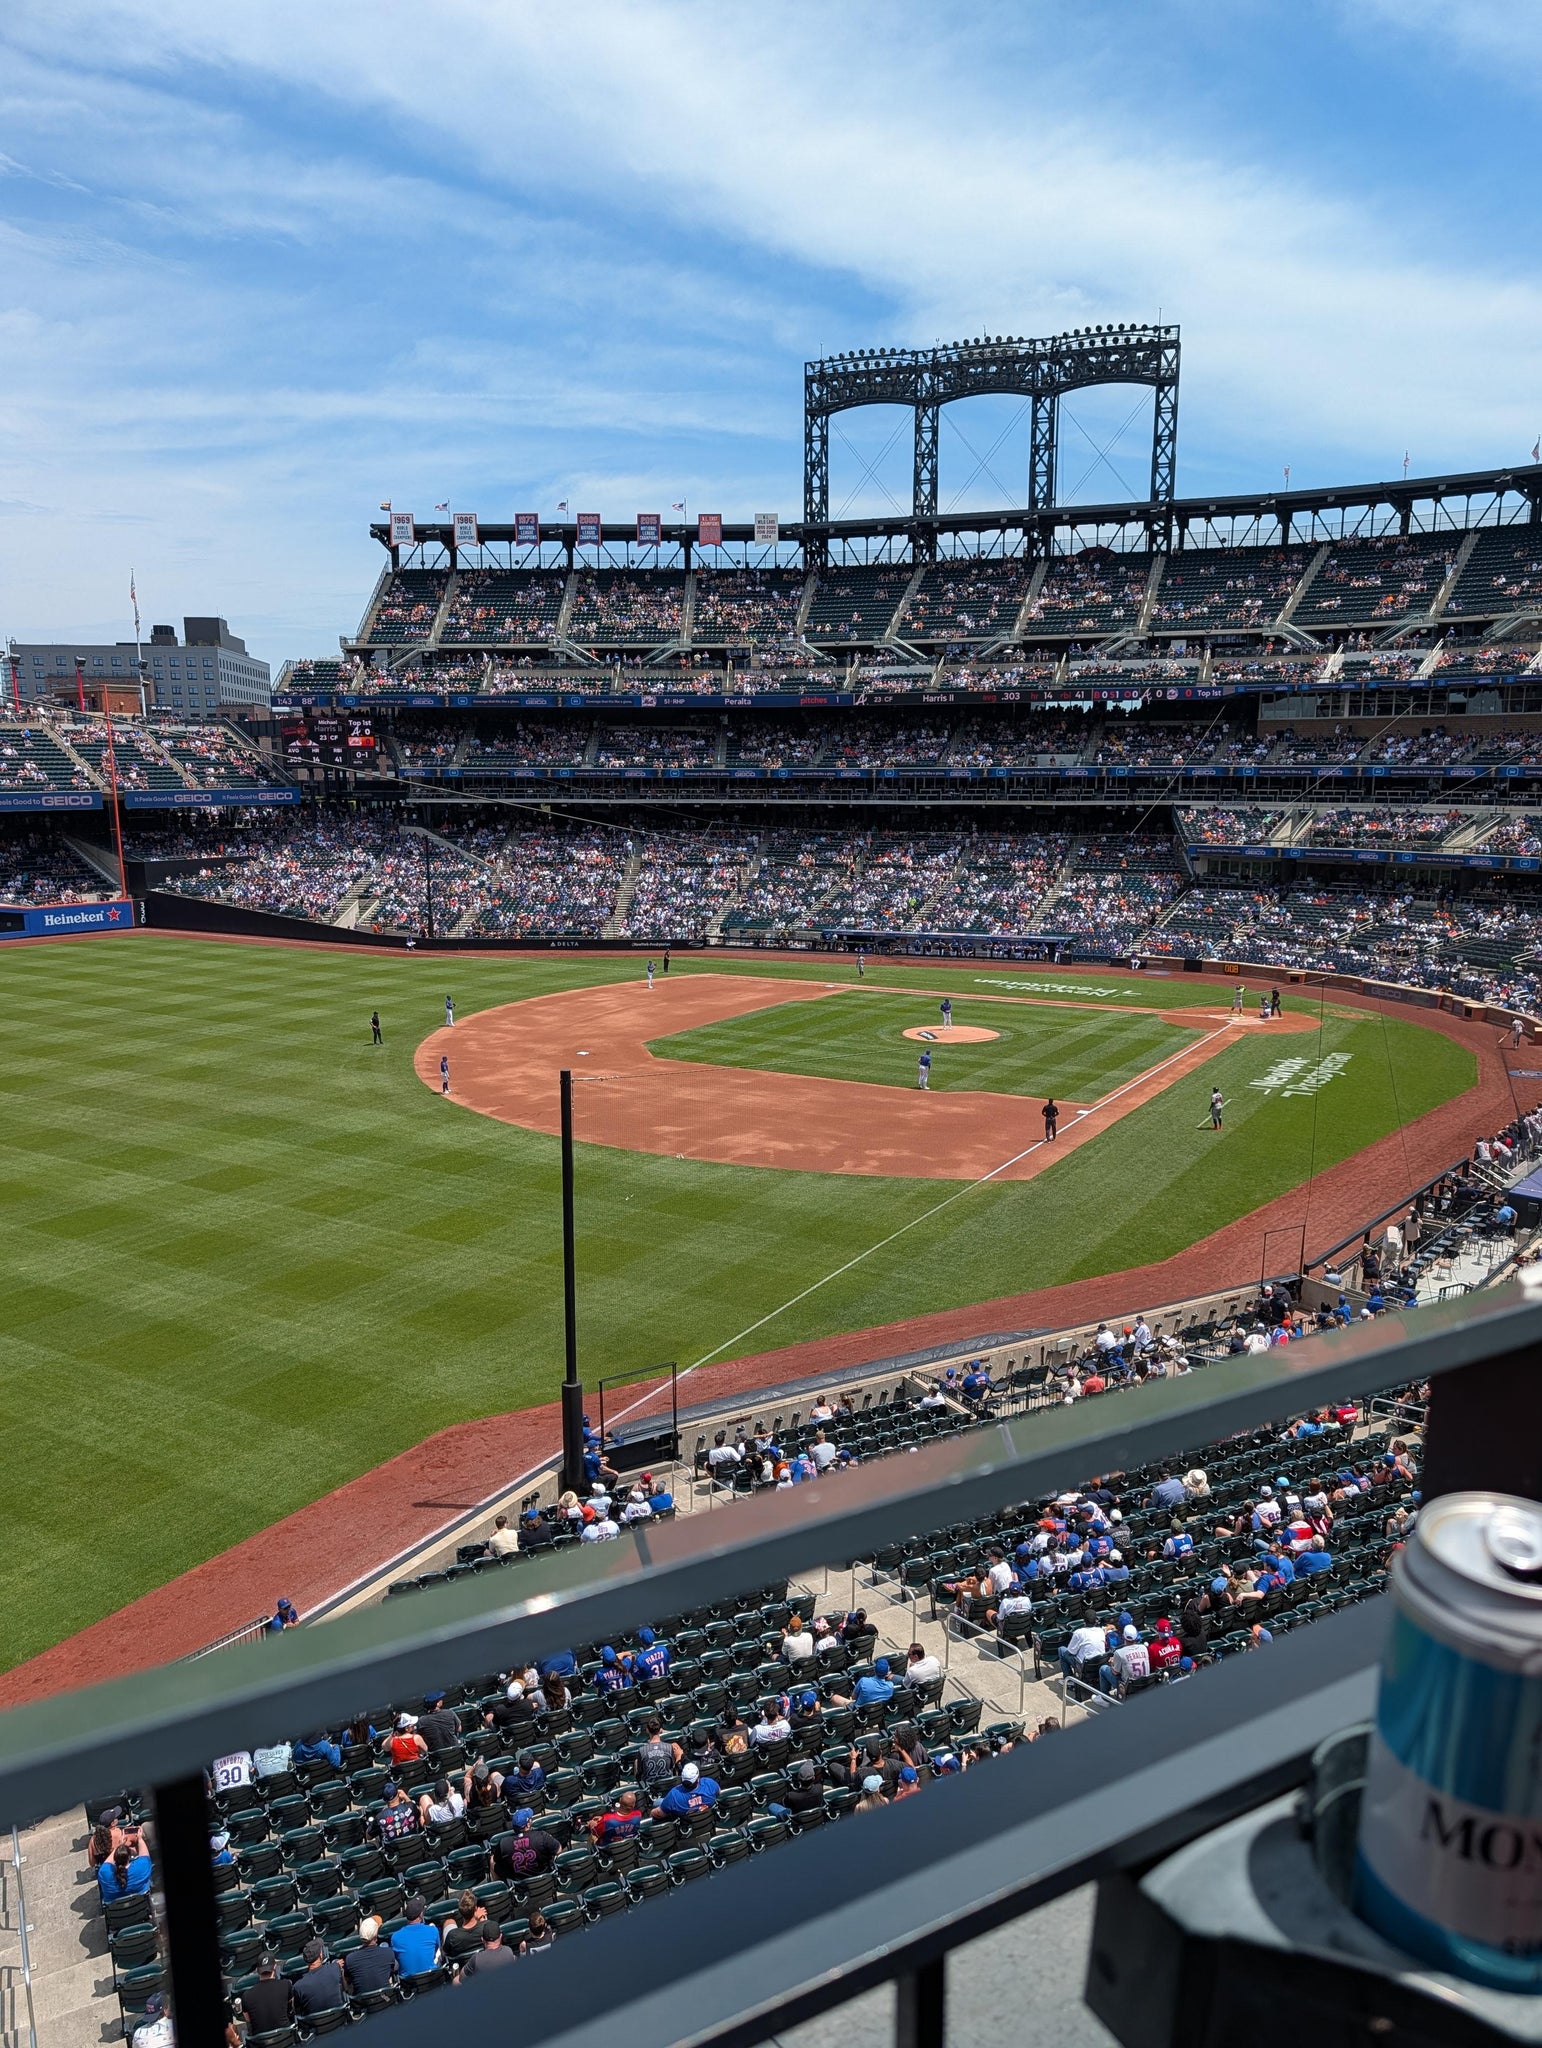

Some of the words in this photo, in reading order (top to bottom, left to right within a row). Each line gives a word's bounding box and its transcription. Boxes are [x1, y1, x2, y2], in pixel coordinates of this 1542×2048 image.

[394, 516, 410, 524] 1969
[457, 516, 473, 524] 1986
[518, 516, 535, 524] 1973
[923, 694, 947, 702] Harris
[1001, 692, 1020, 700] .303
[1075, 691, 1084, 699] 41
[725, 697, 752, 705] Peralta
[348, 720, 361, 728] Top
[42, 796, 93, 806] GEICO
[174, 794, 212, 802] GEICO
[258, 792, 293, 800] GEICO
[44, 910, 105, 926] Heineken
[645, 1650, 664, 1665] PIAZZA
[1125, 1651, 1147, 1662] PERALTA
[650, 1660, 665, 1679] 31
[1131, 1660, 1147, 1678] 51
[216, 1756, 244, 1769] CONFORTO
[647, 1757, 668, 1778] 22
[219, 1765, 242, 1787] 30
[513, 1837, 531, 1850] SOTO
[512, 1849, 538, 1874] 22
